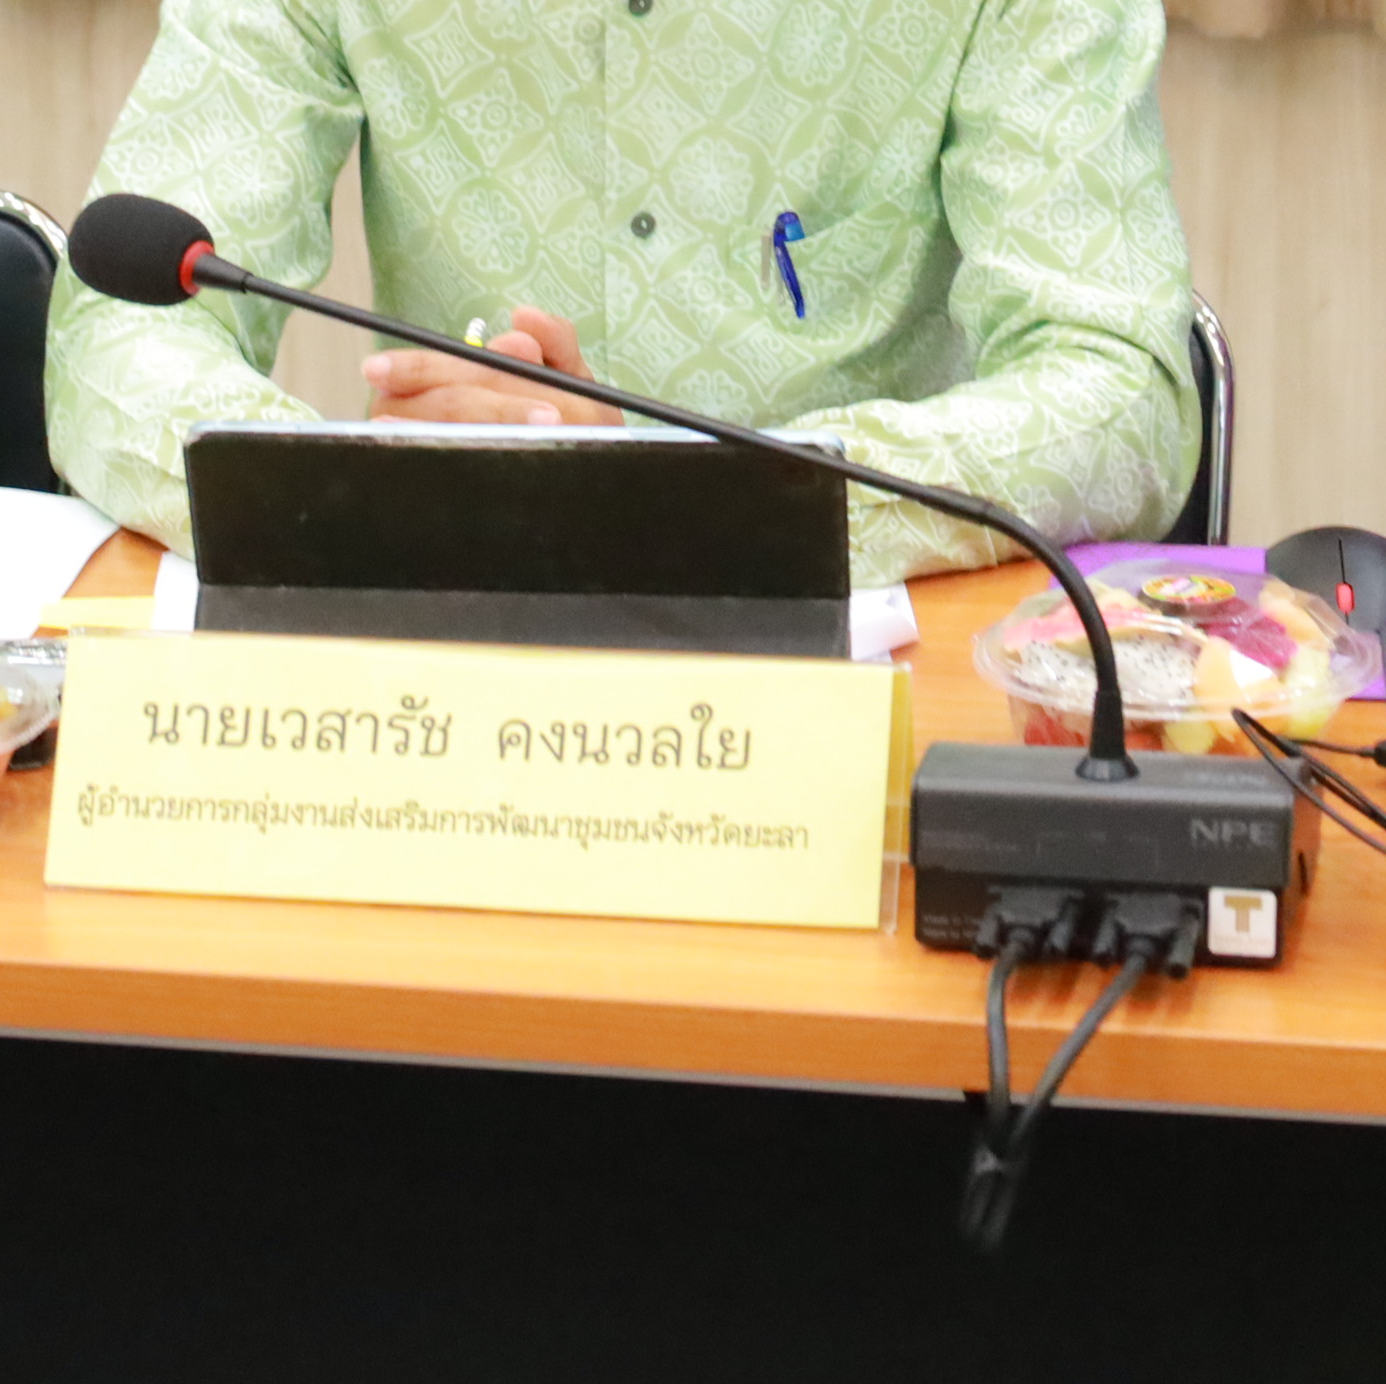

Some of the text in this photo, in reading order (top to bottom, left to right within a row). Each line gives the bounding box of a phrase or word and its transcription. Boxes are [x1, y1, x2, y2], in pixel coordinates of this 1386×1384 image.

[142, 694, 751, 771] นายเวสารัช คงนวลใย
[1189, 817, 1279, 848] NPE
